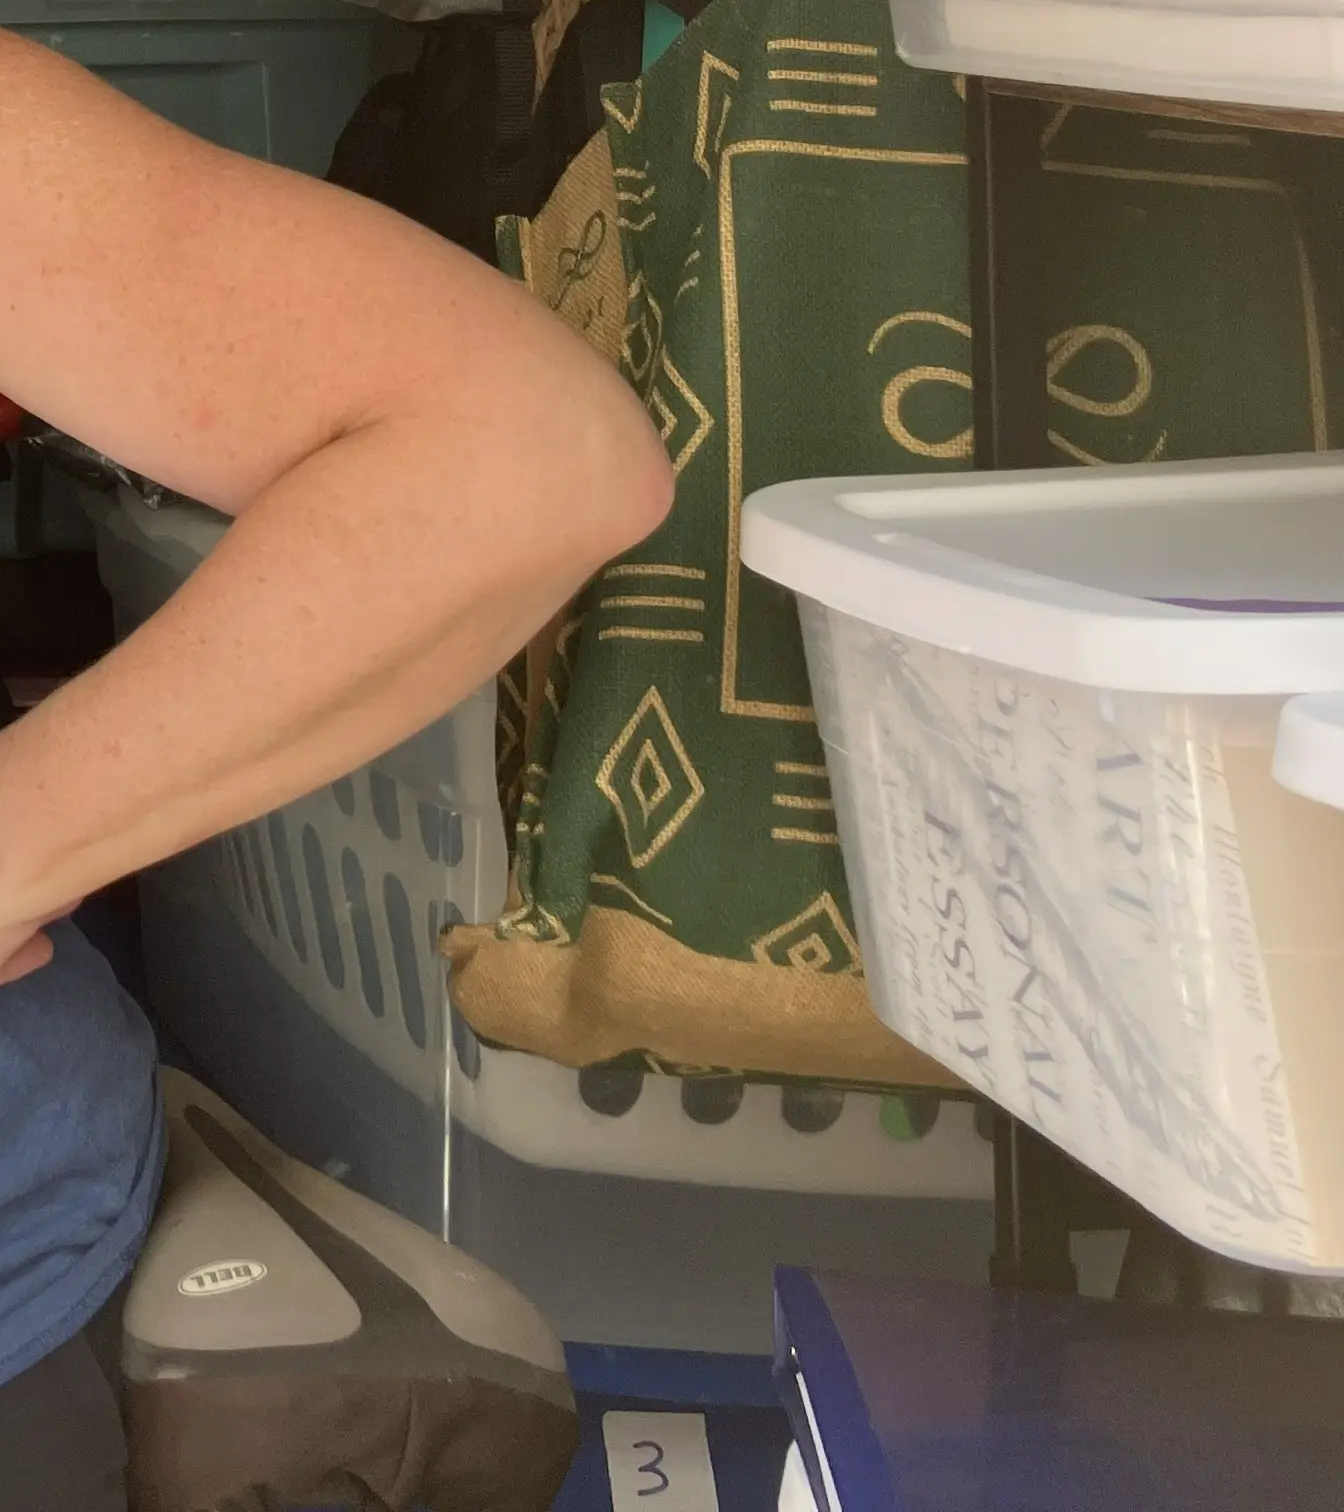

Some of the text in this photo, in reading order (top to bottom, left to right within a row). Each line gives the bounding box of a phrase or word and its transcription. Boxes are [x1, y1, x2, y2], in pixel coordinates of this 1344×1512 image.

[1094, 718, 1159, 945] ART
[922, 810, 999, 1094] ESSAY
[189, 1264, 253, 1287] BELL
[632, 1440, 669, 1497] 3
